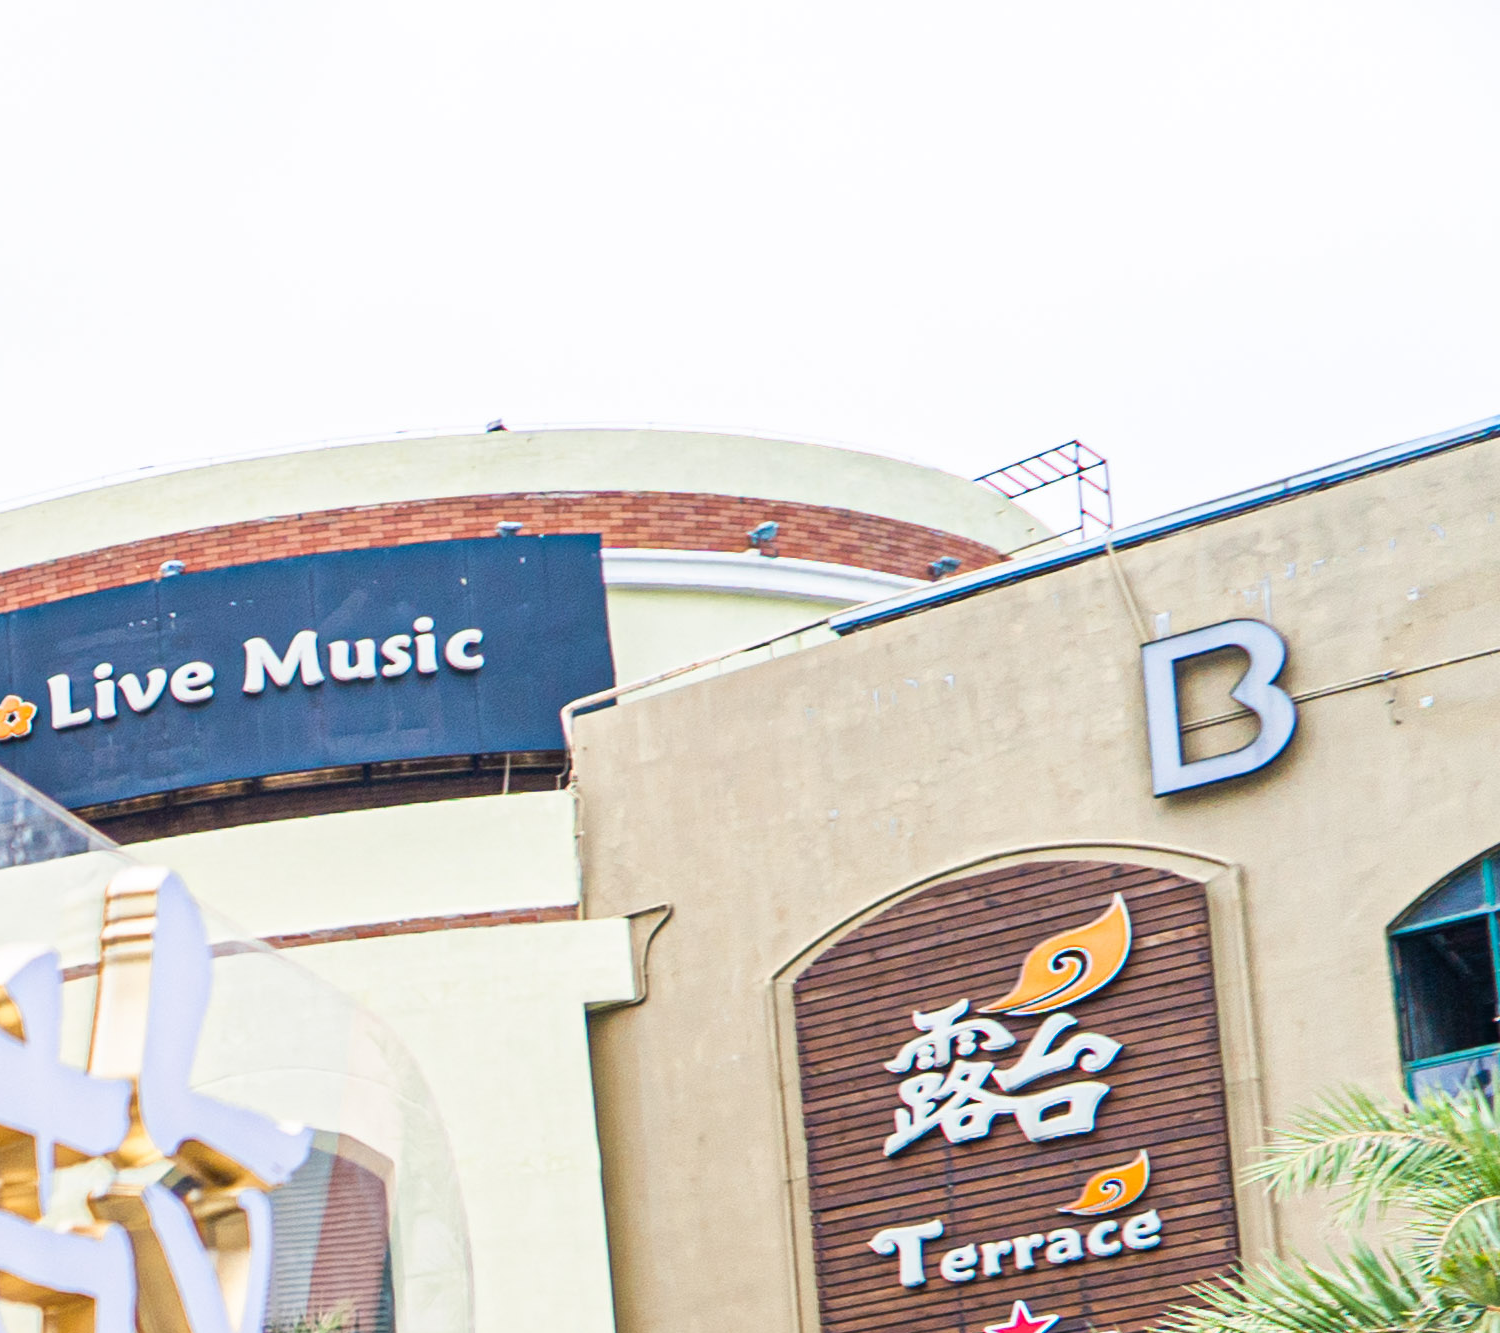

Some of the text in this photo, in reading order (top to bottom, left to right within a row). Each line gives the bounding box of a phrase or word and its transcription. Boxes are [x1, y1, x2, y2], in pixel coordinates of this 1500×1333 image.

[46, 650, 216, 733] Live
[241, 614, 488, 696] Music
[1140, 618, 1298, 798] B
[884, 997, 1125, 1157] 露台
[868, 1208, 1162, 1288] Terrace
